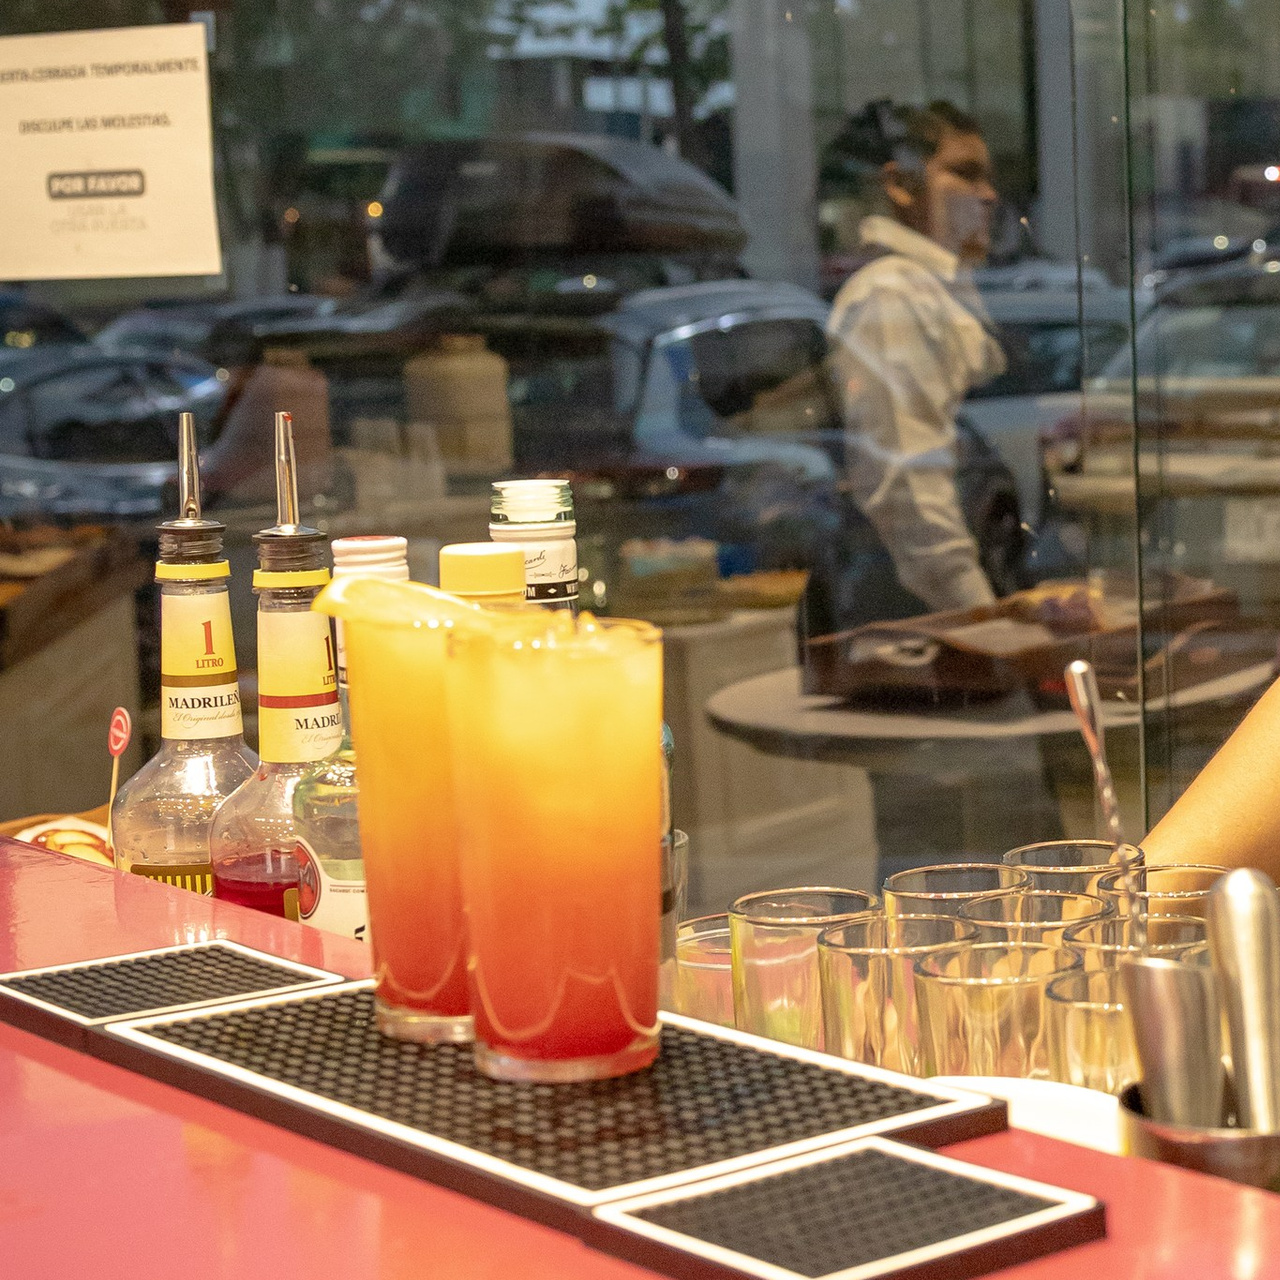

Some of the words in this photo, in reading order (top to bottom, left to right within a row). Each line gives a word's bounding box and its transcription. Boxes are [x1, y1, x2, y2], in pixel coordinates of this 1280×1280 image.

[201, 620, 216, 655] 1
[324, 635, 333, 672] 1
[195, 657, 224, 669] LITRO
